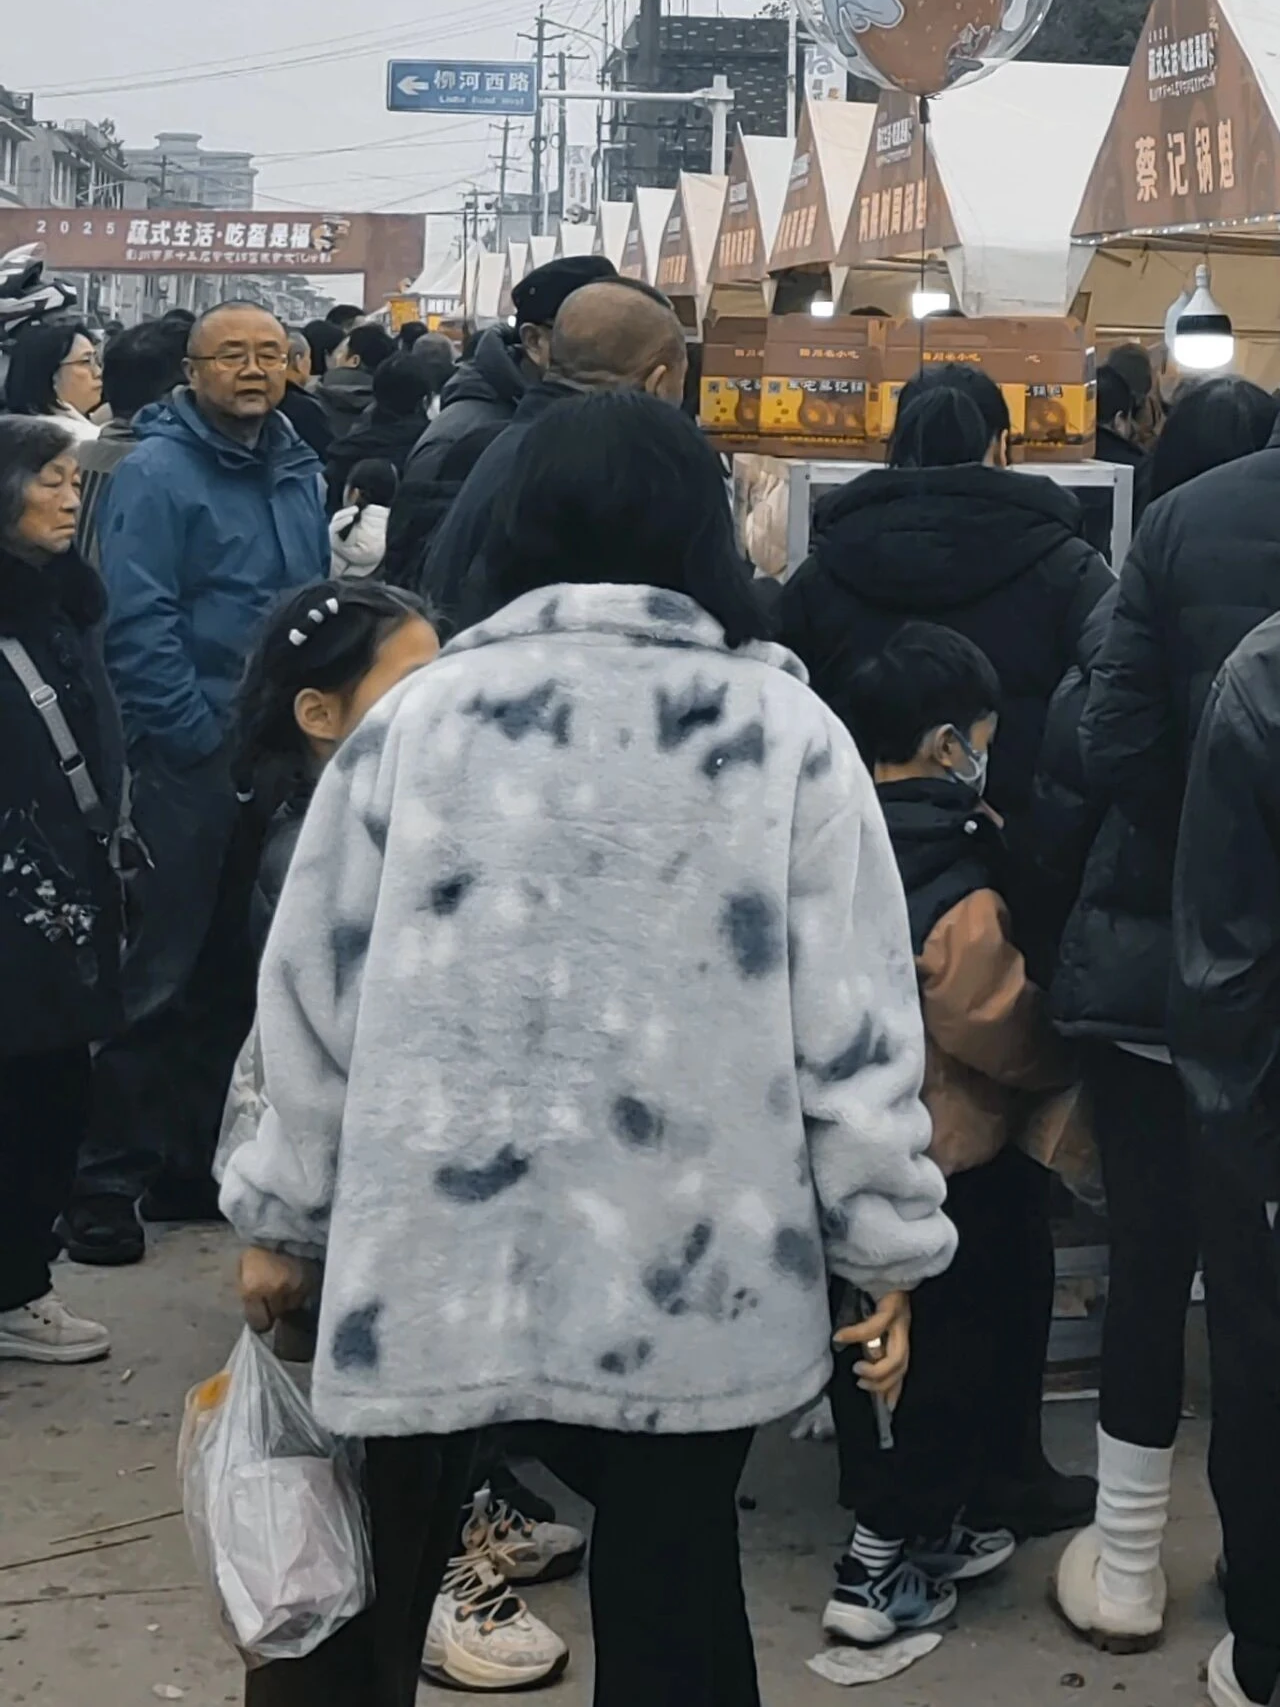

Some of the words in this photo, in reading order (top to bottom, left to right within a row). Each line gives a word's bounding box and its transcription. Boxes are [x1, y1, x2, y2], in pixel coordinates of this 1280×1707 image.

[433, 69, 530, 92] 柳河西路
[36, 221, 115, 235] 2025
